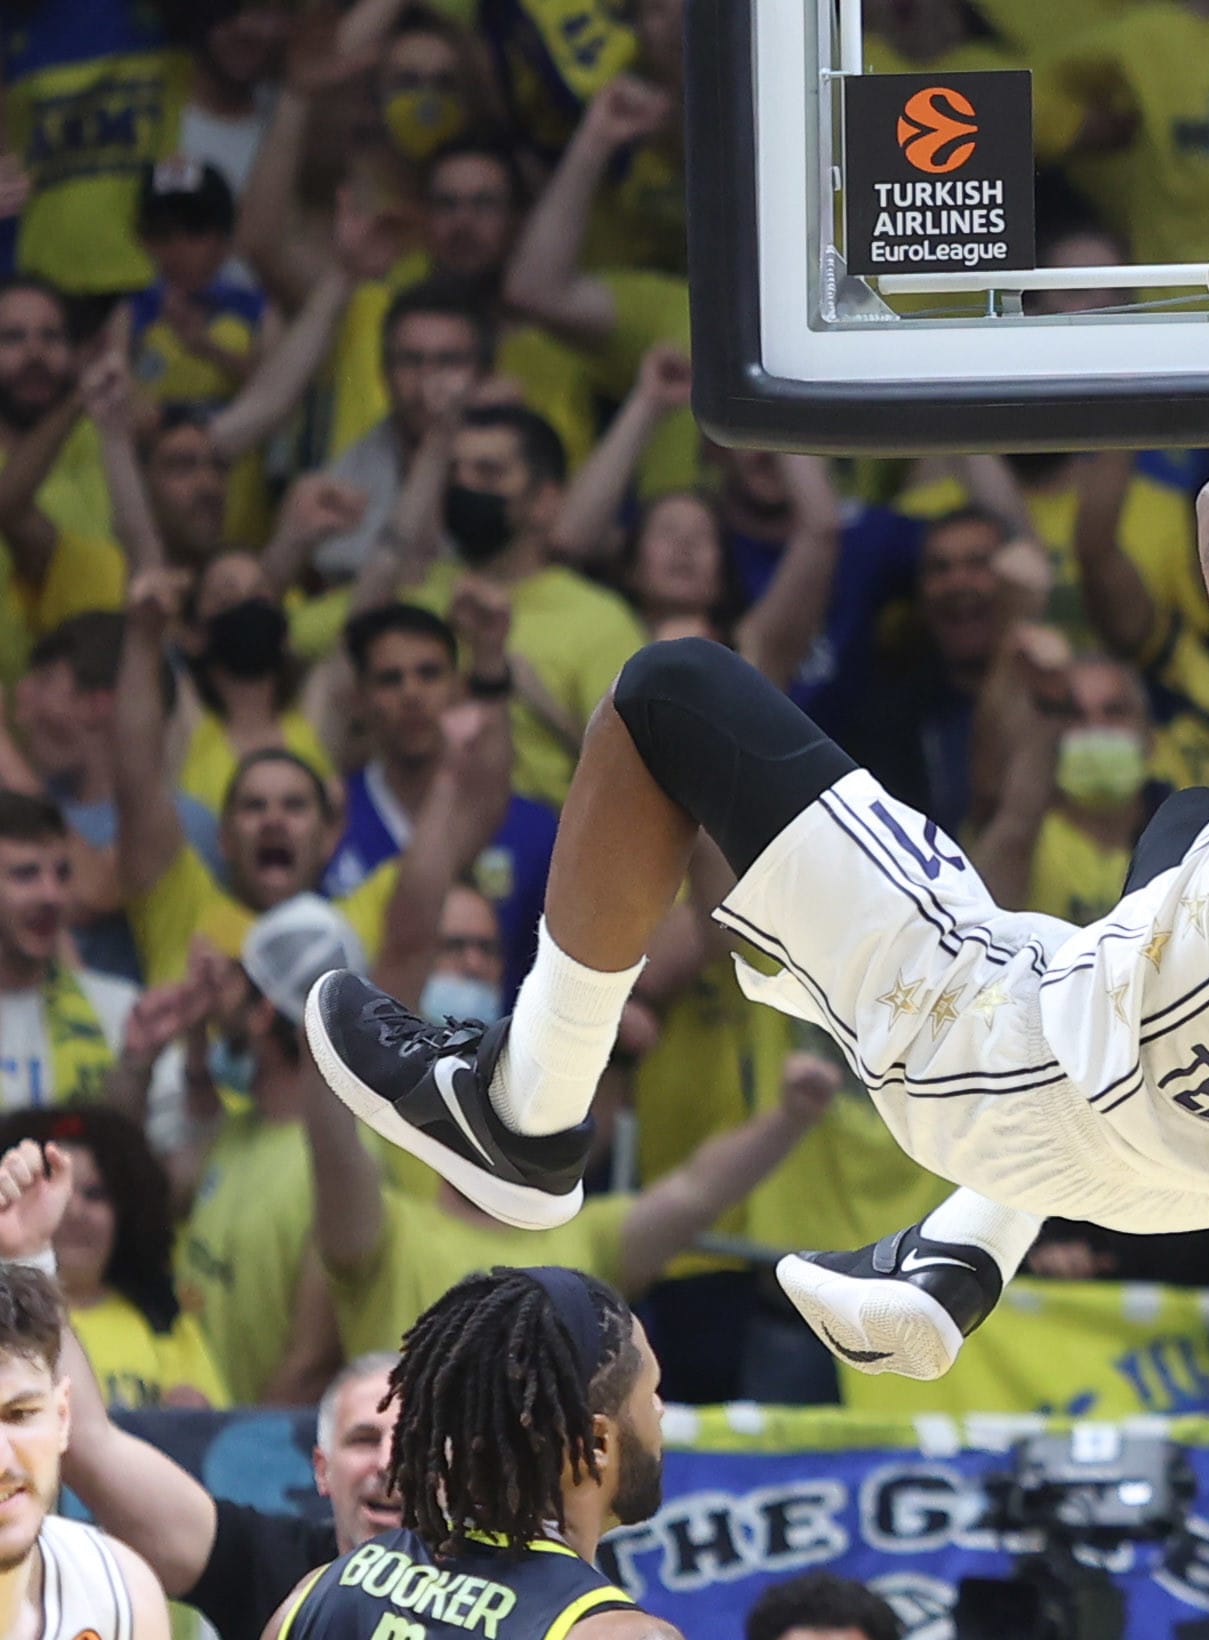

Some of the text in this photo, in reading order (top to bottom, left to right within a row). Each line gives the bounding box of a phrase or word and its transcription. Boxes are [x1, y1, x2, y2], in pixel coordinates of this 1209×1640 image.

[874, 180, 1003, 207] TURKISH
[873, 209, 1005, 236] AIRLINES
[871, 240, 1007, 266] EuroLeague
[339, 1544, 516, 1639] BOOKER
